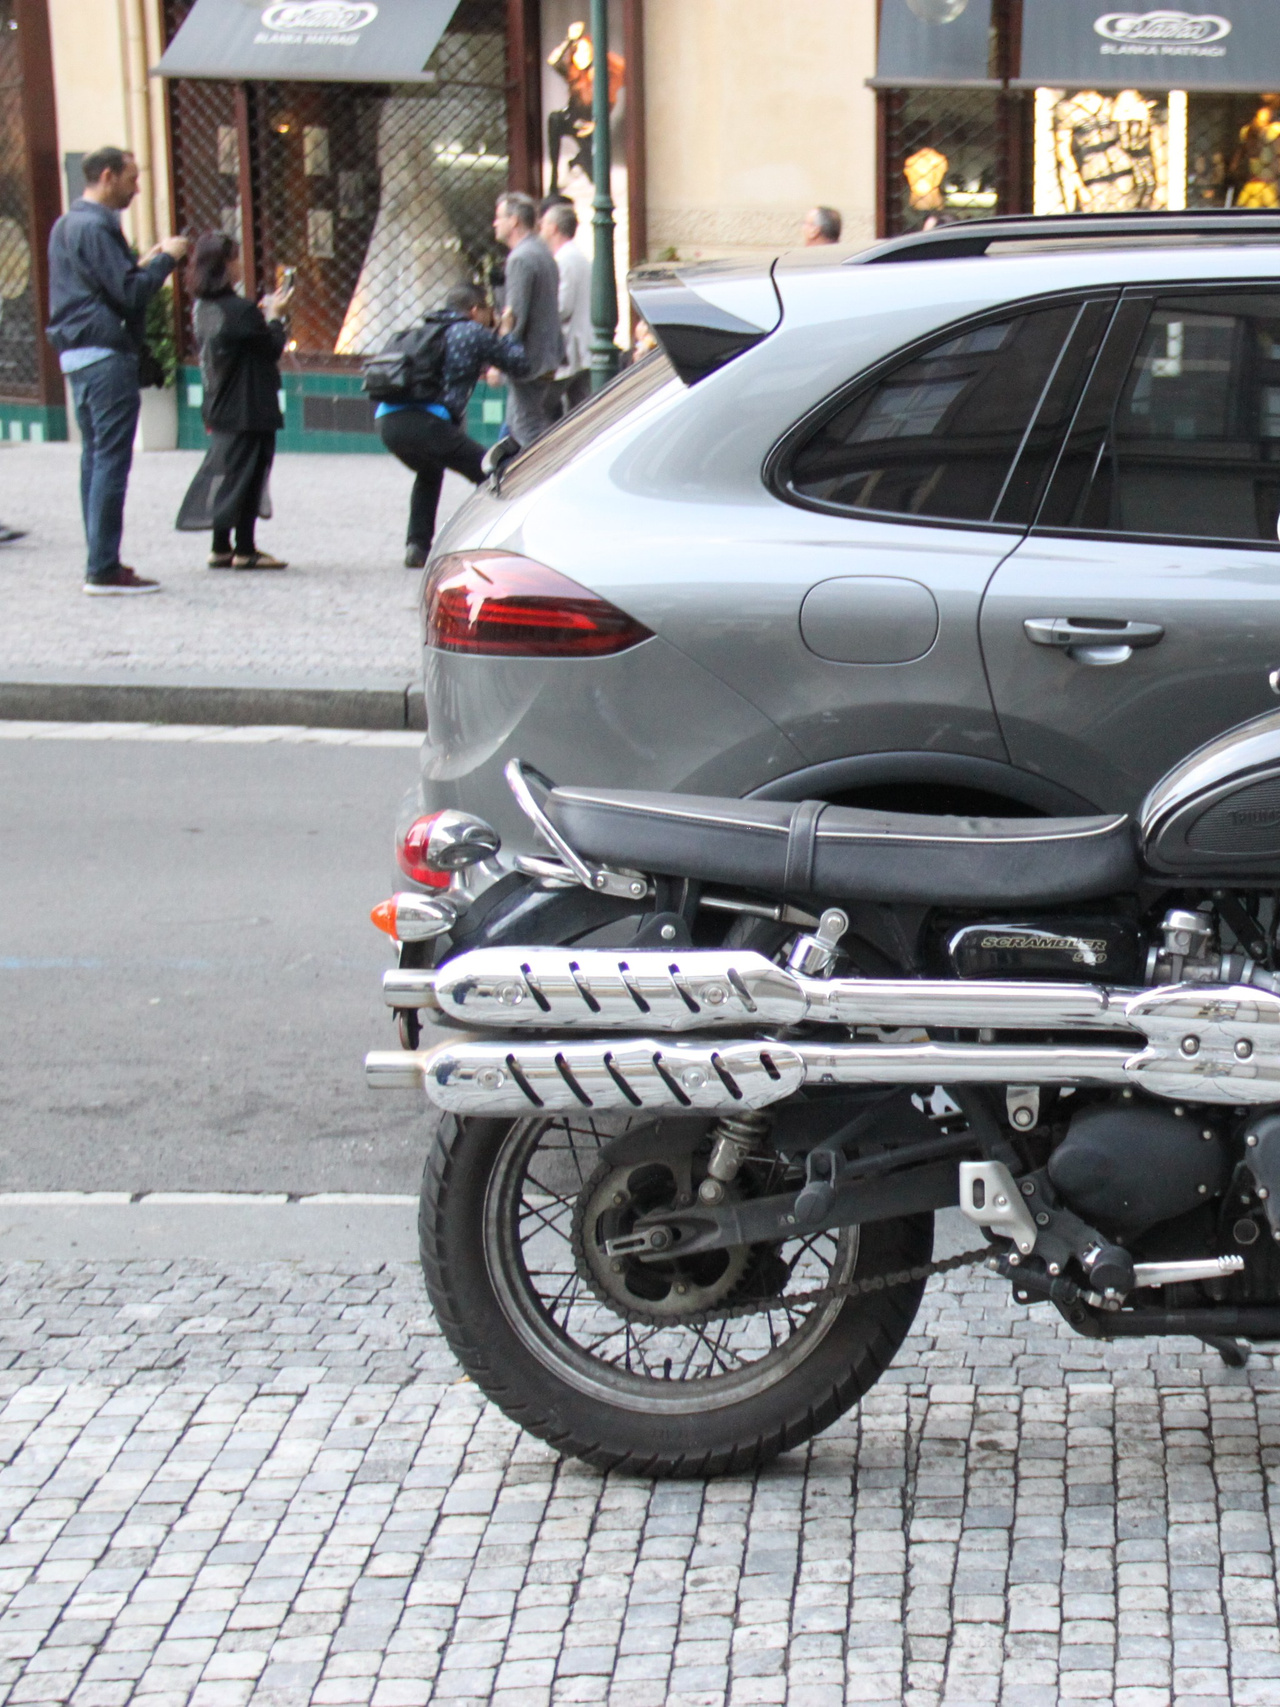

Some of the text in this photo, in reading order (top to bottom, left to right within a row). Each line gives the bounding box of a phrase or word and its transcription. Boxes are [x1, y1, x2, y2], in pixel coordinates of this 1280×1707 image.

[1100, 43, 1227, 57] BLANKA MATRAGI
[981, 936, 1107, 951] SCRAMBLER
[1072, 952, 1107, 964] 90
